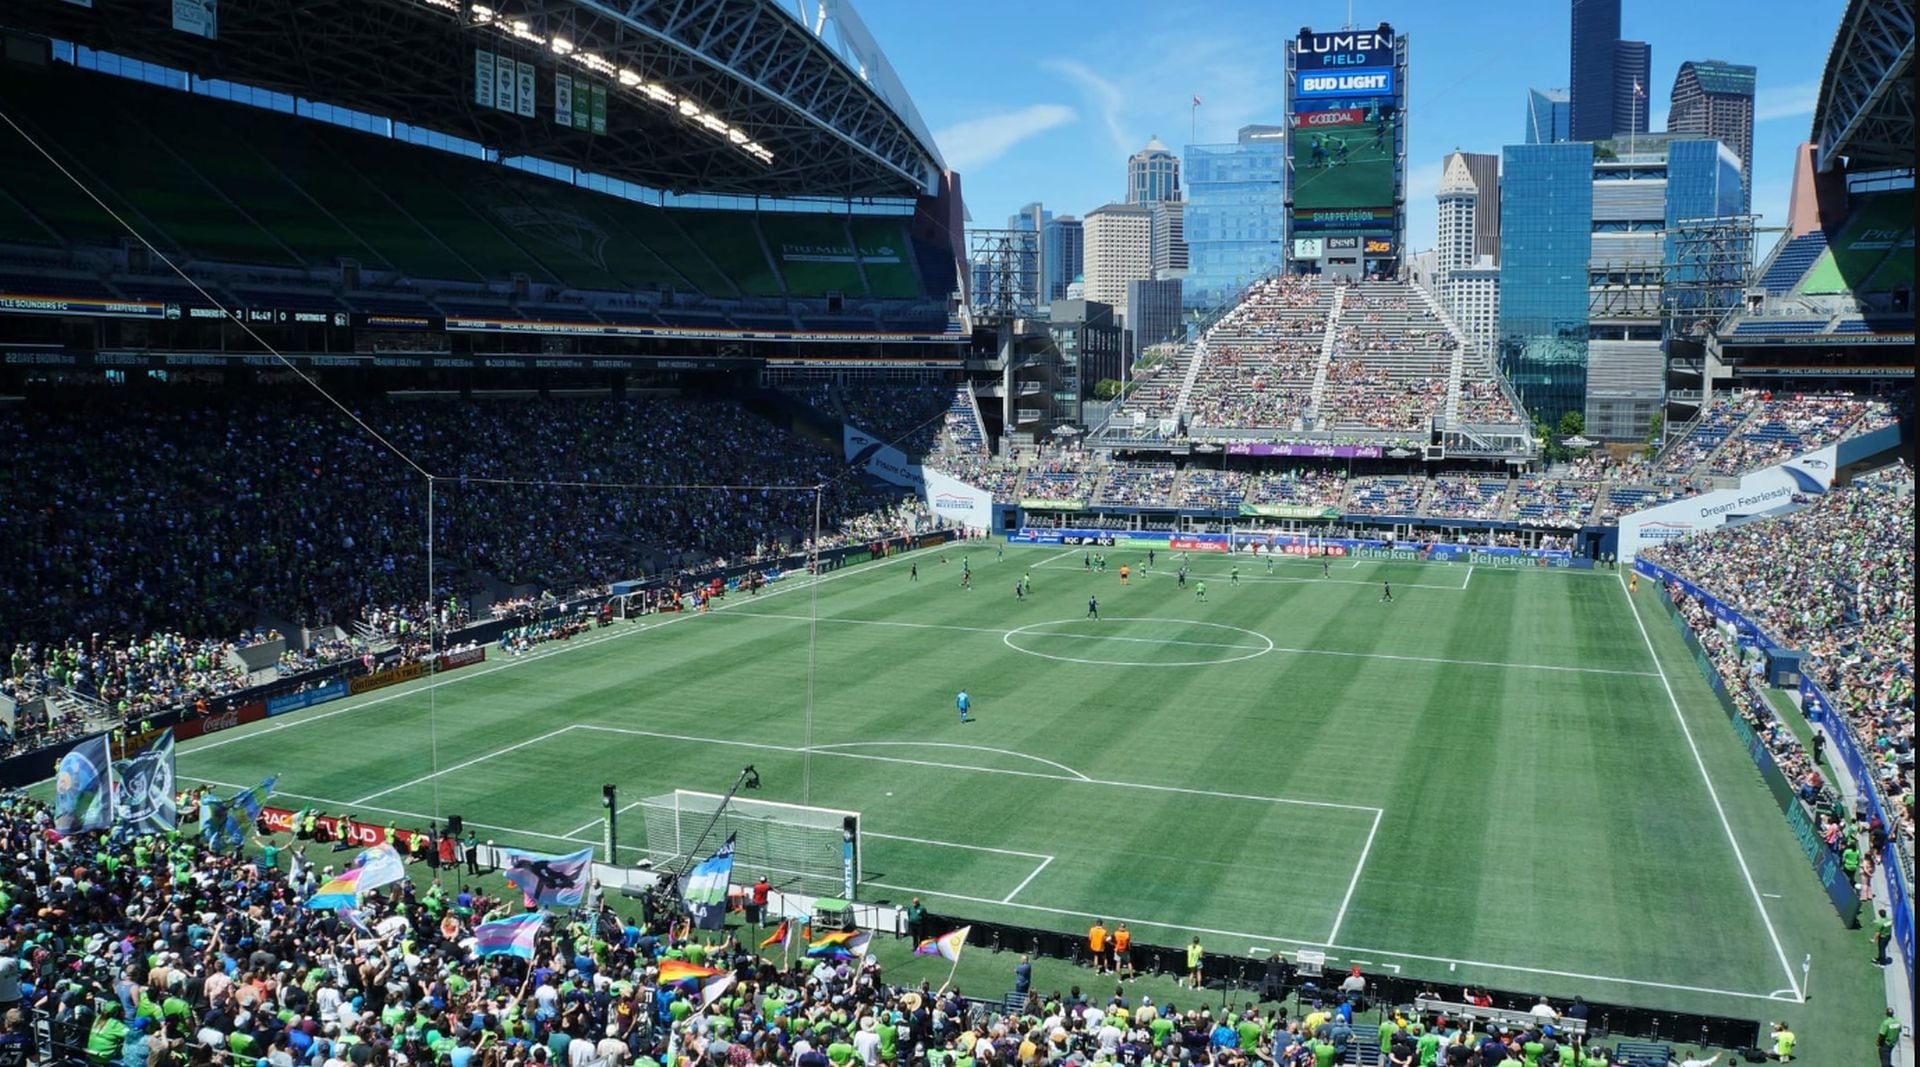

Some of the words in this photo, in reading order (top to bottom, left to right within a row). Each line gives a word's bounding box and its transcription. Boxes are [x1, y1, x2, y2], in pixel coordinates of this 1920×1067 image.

[1297, 34, 1393, 54] LUMEN
[1323, 54, 1366, 66] FIELD
[1303, 77, 1337, 92] BUD
[1338, 74, 1386, 90] LIGHT
[16, 301, 56, 310] SOUNDERS
[236, 310, 242, 319] 3
[1700, 502, 1736, 519] Dream
[1738, 485, 1792, 508] Fearlessly
[1351, 547, 1415, 560] Heineken
[1469, 553, 1536, 567] Heineken
[351, 671, 395, 692] Continental
[1787, 796, 1820, 864] Heineken
